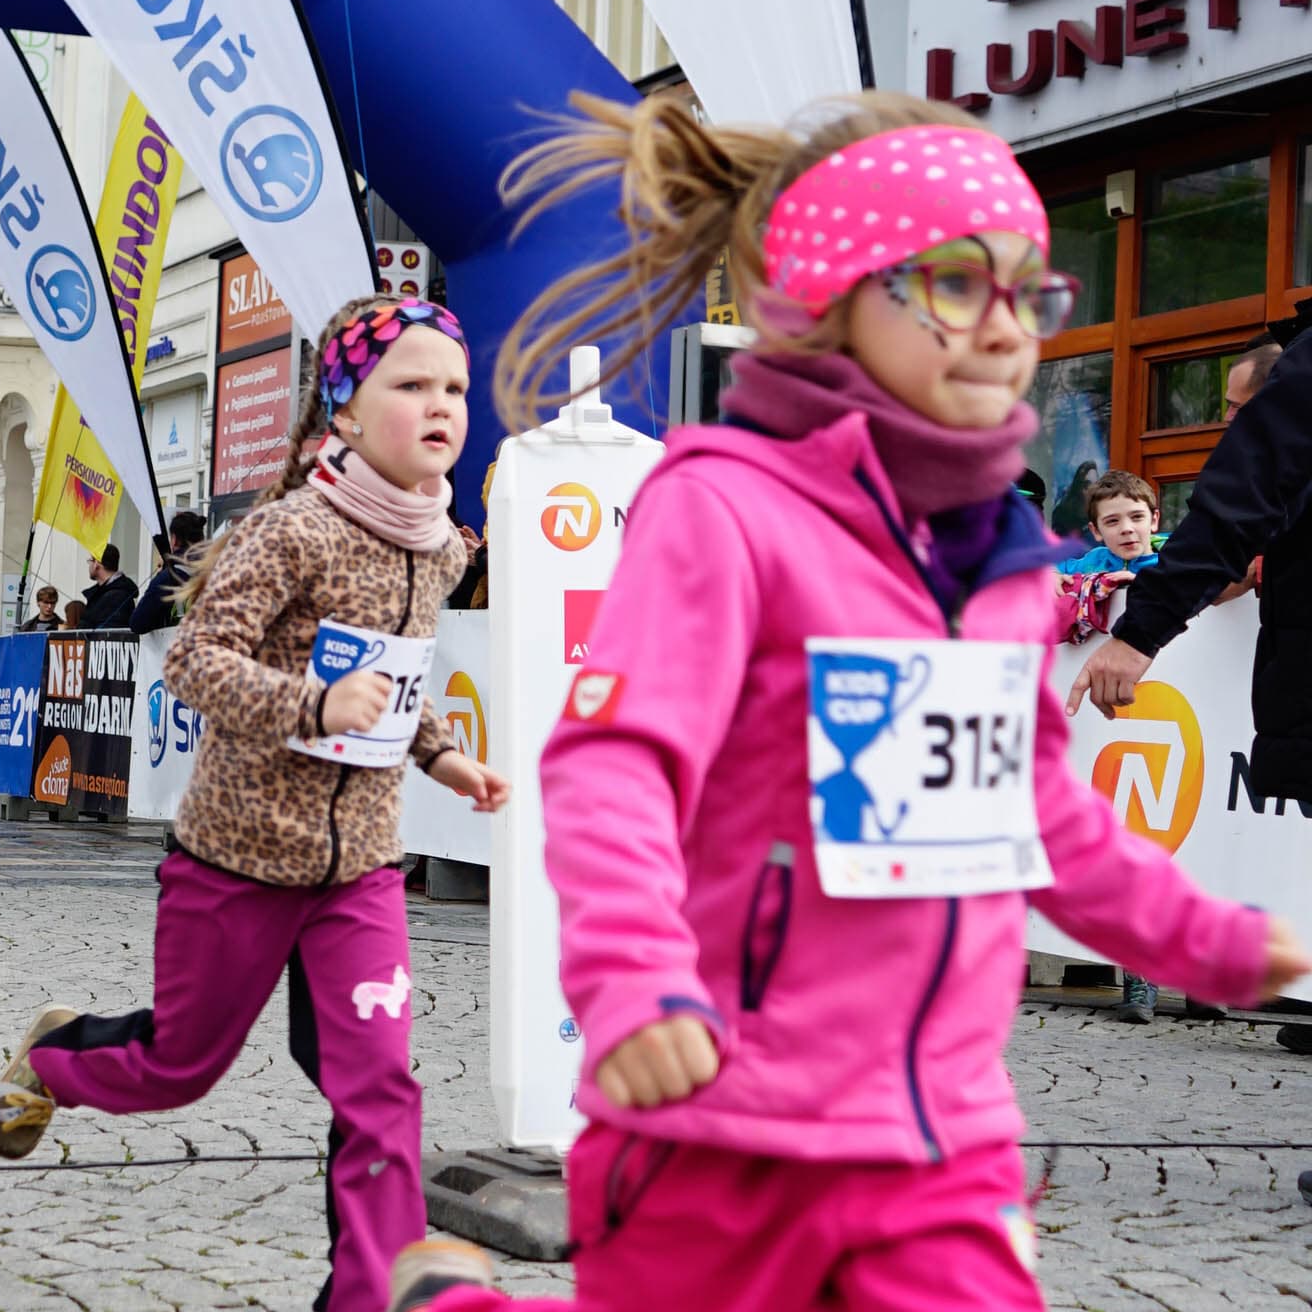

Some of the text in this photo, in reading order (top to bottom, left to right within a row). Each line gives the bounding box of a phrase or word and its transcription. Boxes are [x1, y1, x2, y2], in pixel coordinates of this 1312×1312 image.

[65, 453, 118, 497] PERSKINDOL
[321, 653, 353, 670] CUP
[323, 638, 359, 658] KIDS
[47, 642, 84, 698] Náš
[44, 701, 82, 730] REGION
